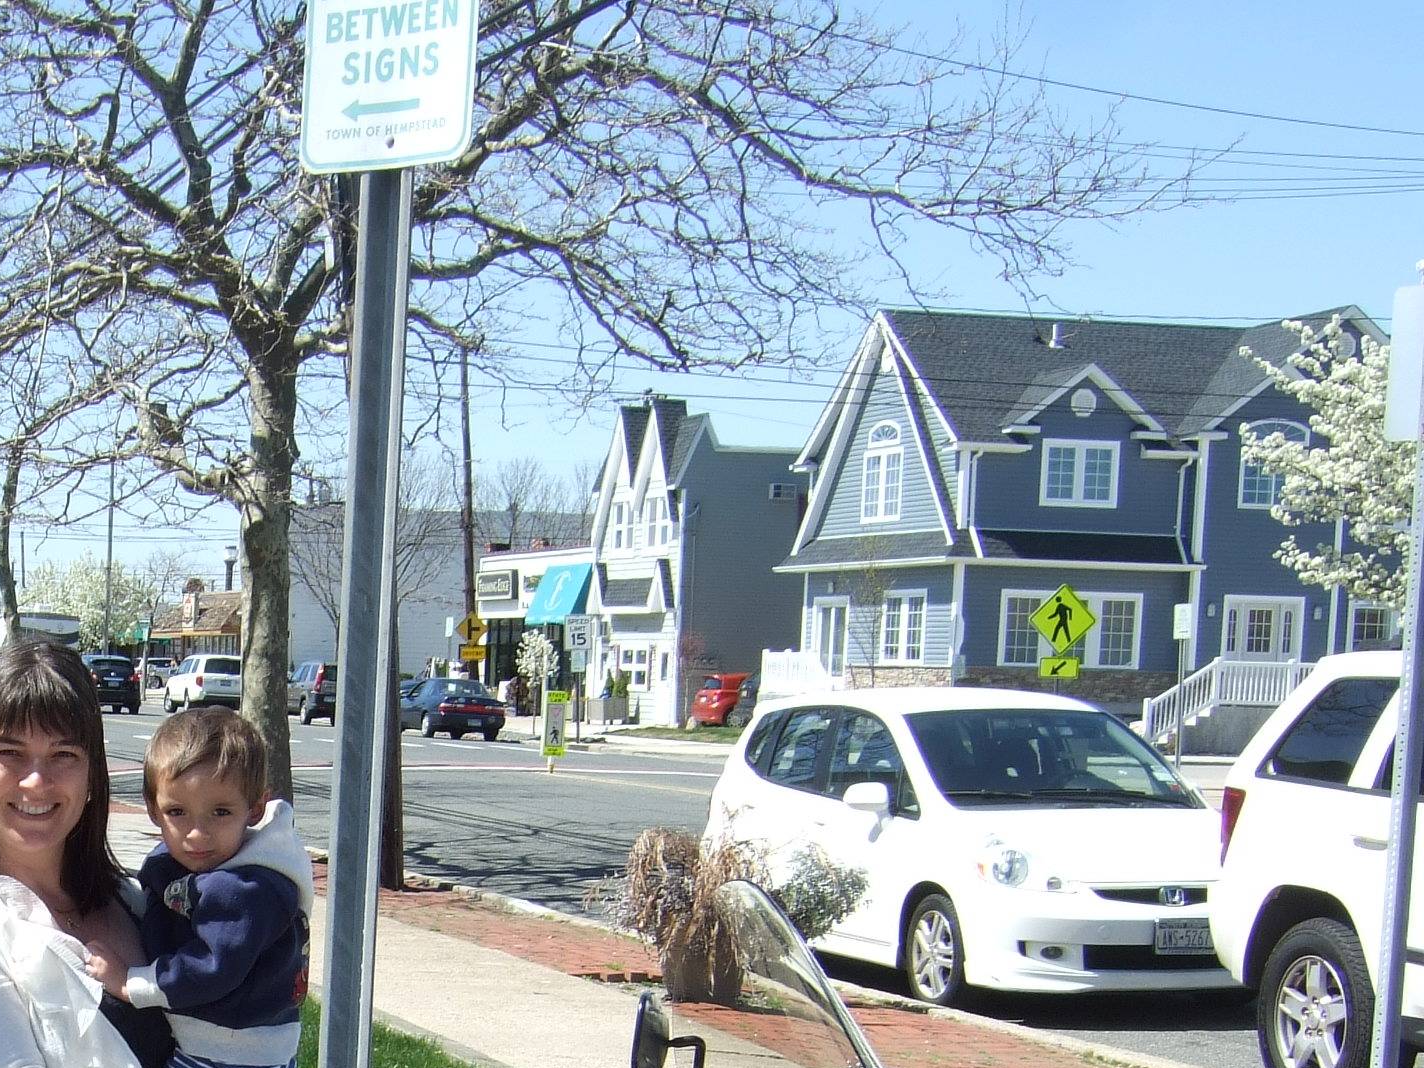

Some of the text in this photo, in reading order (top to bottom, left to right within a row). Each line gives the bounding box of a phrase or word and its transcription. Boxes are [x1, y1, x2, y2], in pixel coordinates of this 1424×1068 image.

[326, 0, 458, 43] BETWEEN
[342, 42, 439, 85] SIGNS
[326, 117, 446, 140] TOWN OF HEMPSTEAD
[571, 632, 587, 646] 15
